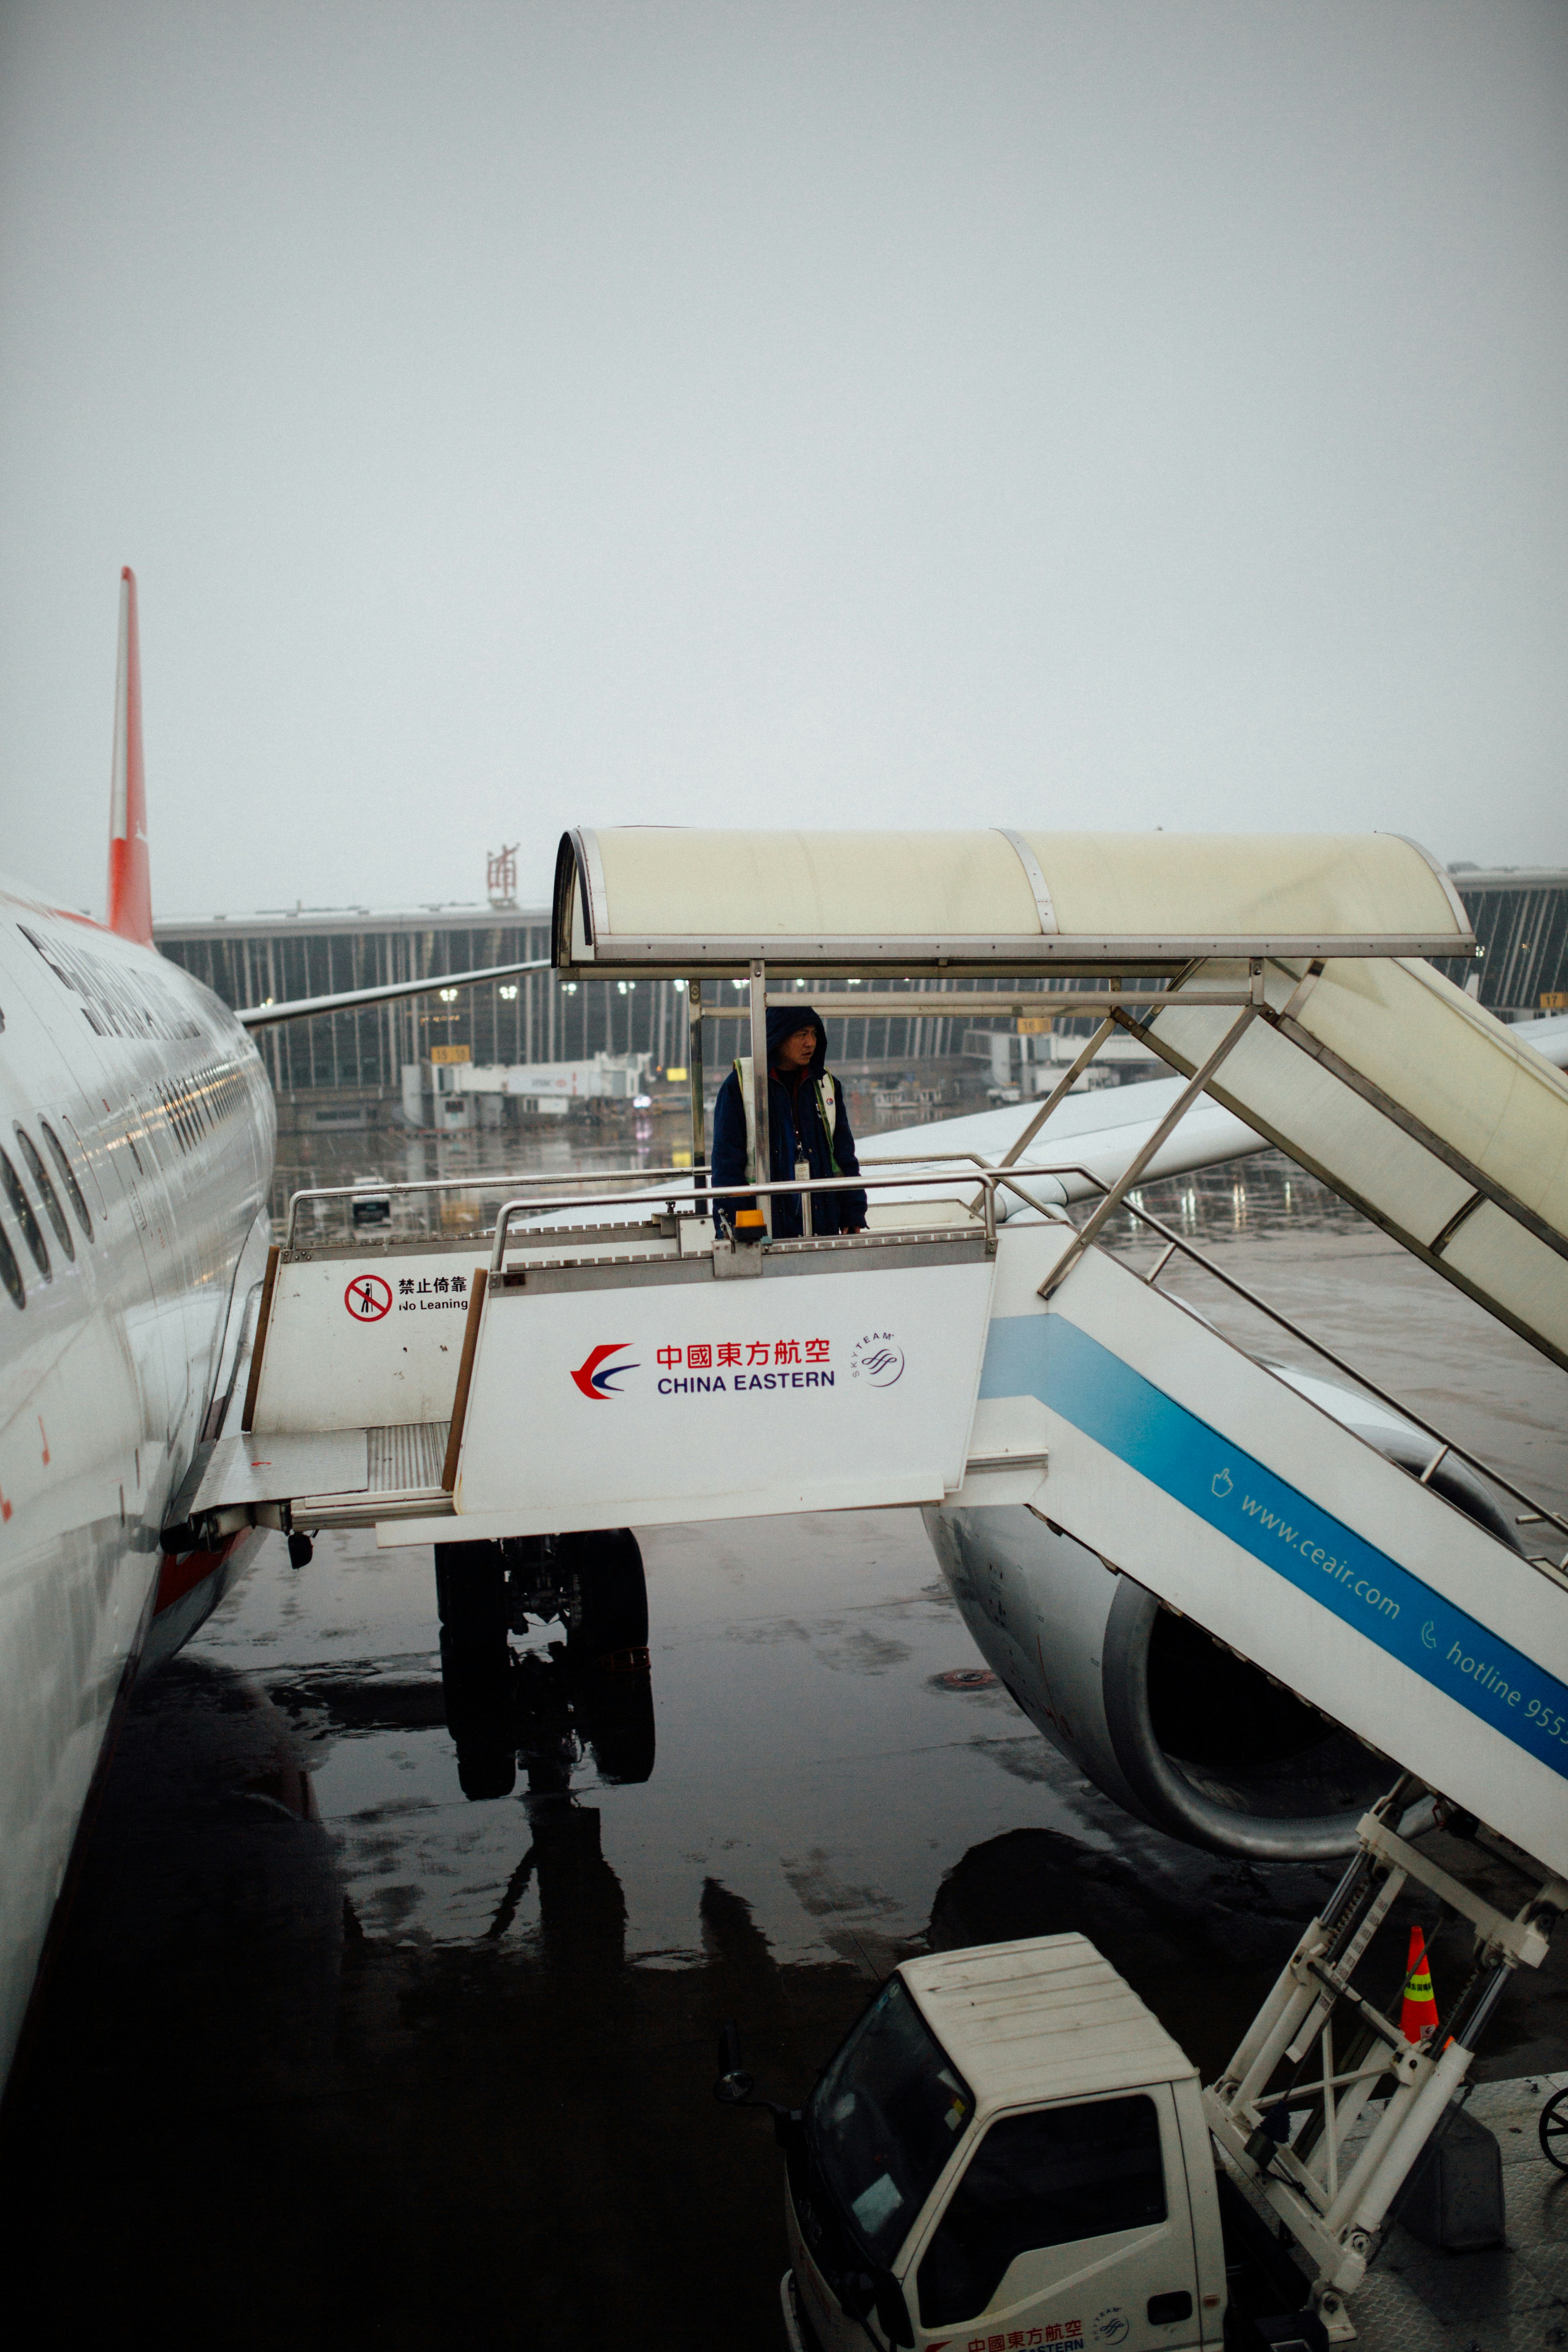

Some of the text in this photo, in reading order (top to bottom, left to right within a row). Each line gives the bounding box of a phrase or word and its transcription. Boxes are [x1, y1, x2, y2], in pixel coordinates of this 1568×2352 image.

[1546, 996, 1557, 1005] 17
[399, 1276, 467, 1295] 禁止倚靠
[399, 1299, 468, 1311] No Leaning
[656, 1338, 831, 1371] 中國東方航空
[851, 1332, 892, 1377] SKYTEAM
[657, 1370, 835, 1395] CHINA EASTERN
[1241, 1495, 1400, 1619] www.ceair.com
[1446, 1641, 1521, 1707] hotline
[968, 2320, 1082, 2352] 中國東方航空
[1019, 2339, 1084, 2352] STERN
